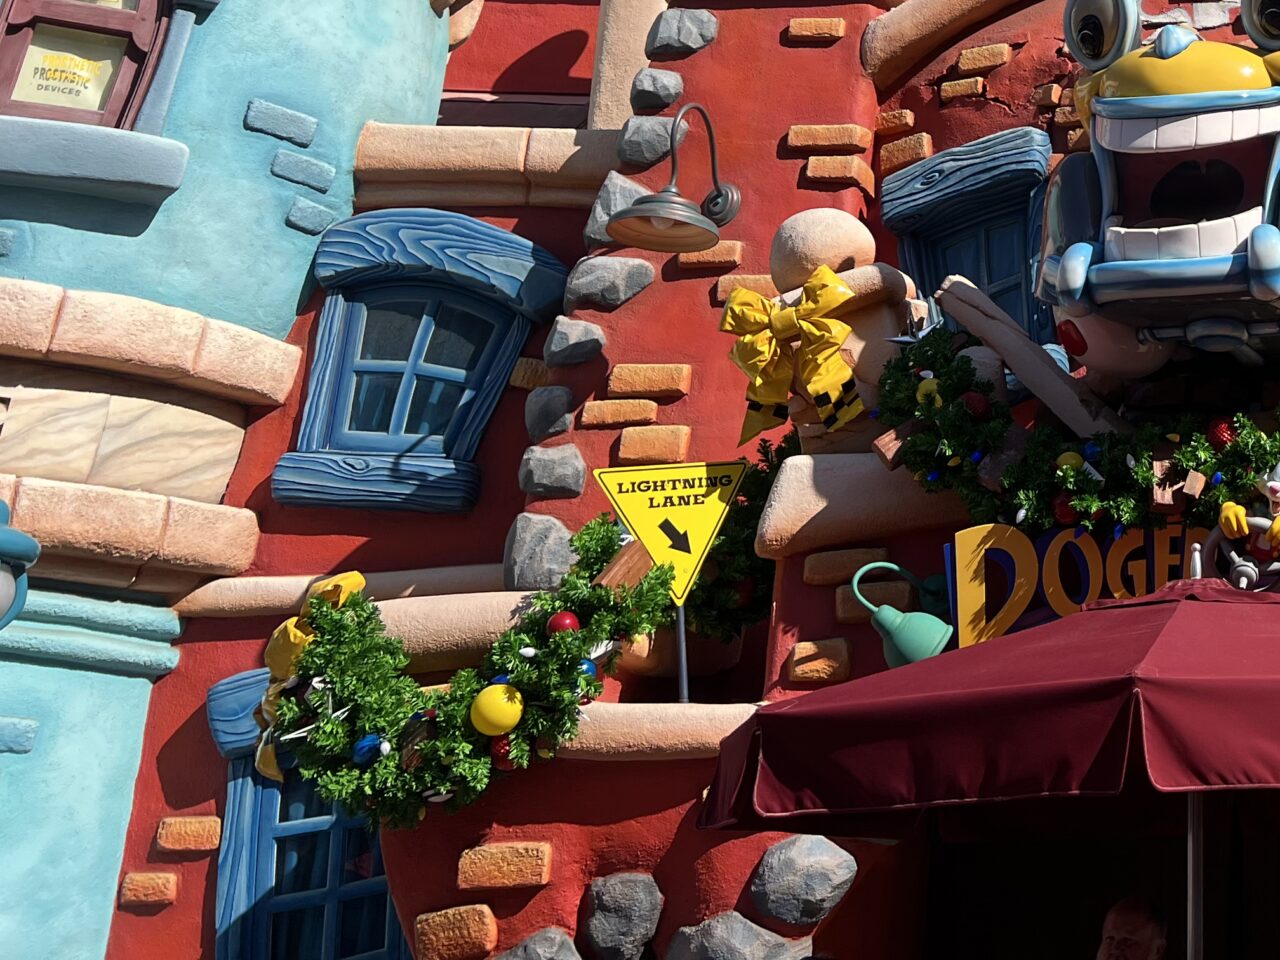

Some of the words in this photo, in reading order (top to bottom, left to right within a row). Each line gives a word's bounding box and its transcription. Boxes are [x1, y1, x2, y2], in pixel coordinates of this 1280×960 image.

[36, 83, 82, 97] DEVICES
[616, 474, 734, 494] LIGHTNING
[648, 494, 705, 509] LANE
